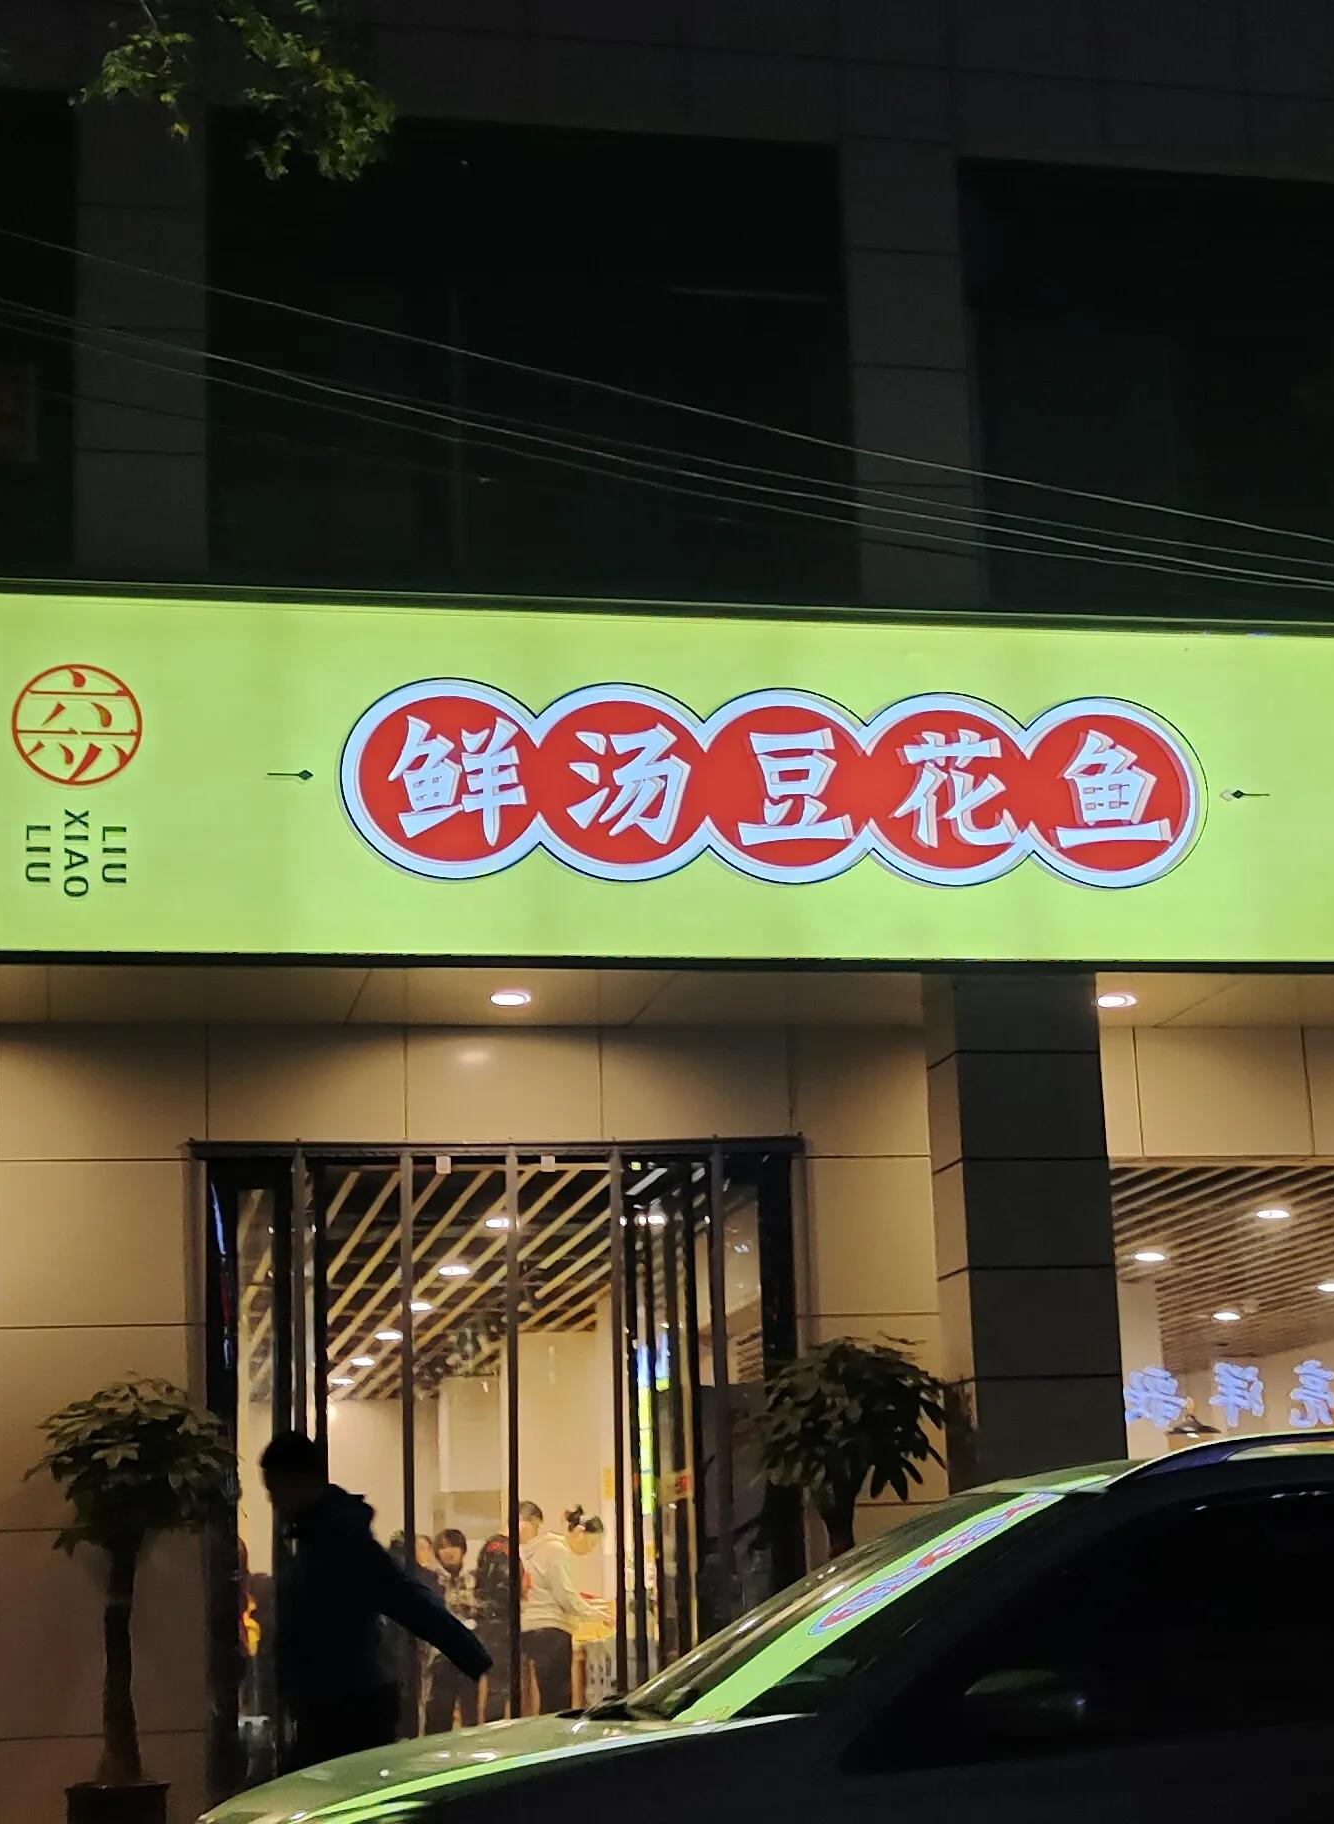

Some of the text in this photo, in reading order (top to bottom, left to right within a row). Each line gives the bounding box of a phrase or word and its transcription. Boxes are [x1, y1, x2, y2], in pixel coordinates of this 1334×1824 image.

[389, 715, 1172, 848] 鲜汤豆花鱼
[25, 824, 51, 883] LIU
[63, 808, 89, 898] XIAO
[101, 825, 127, 884] LIU
